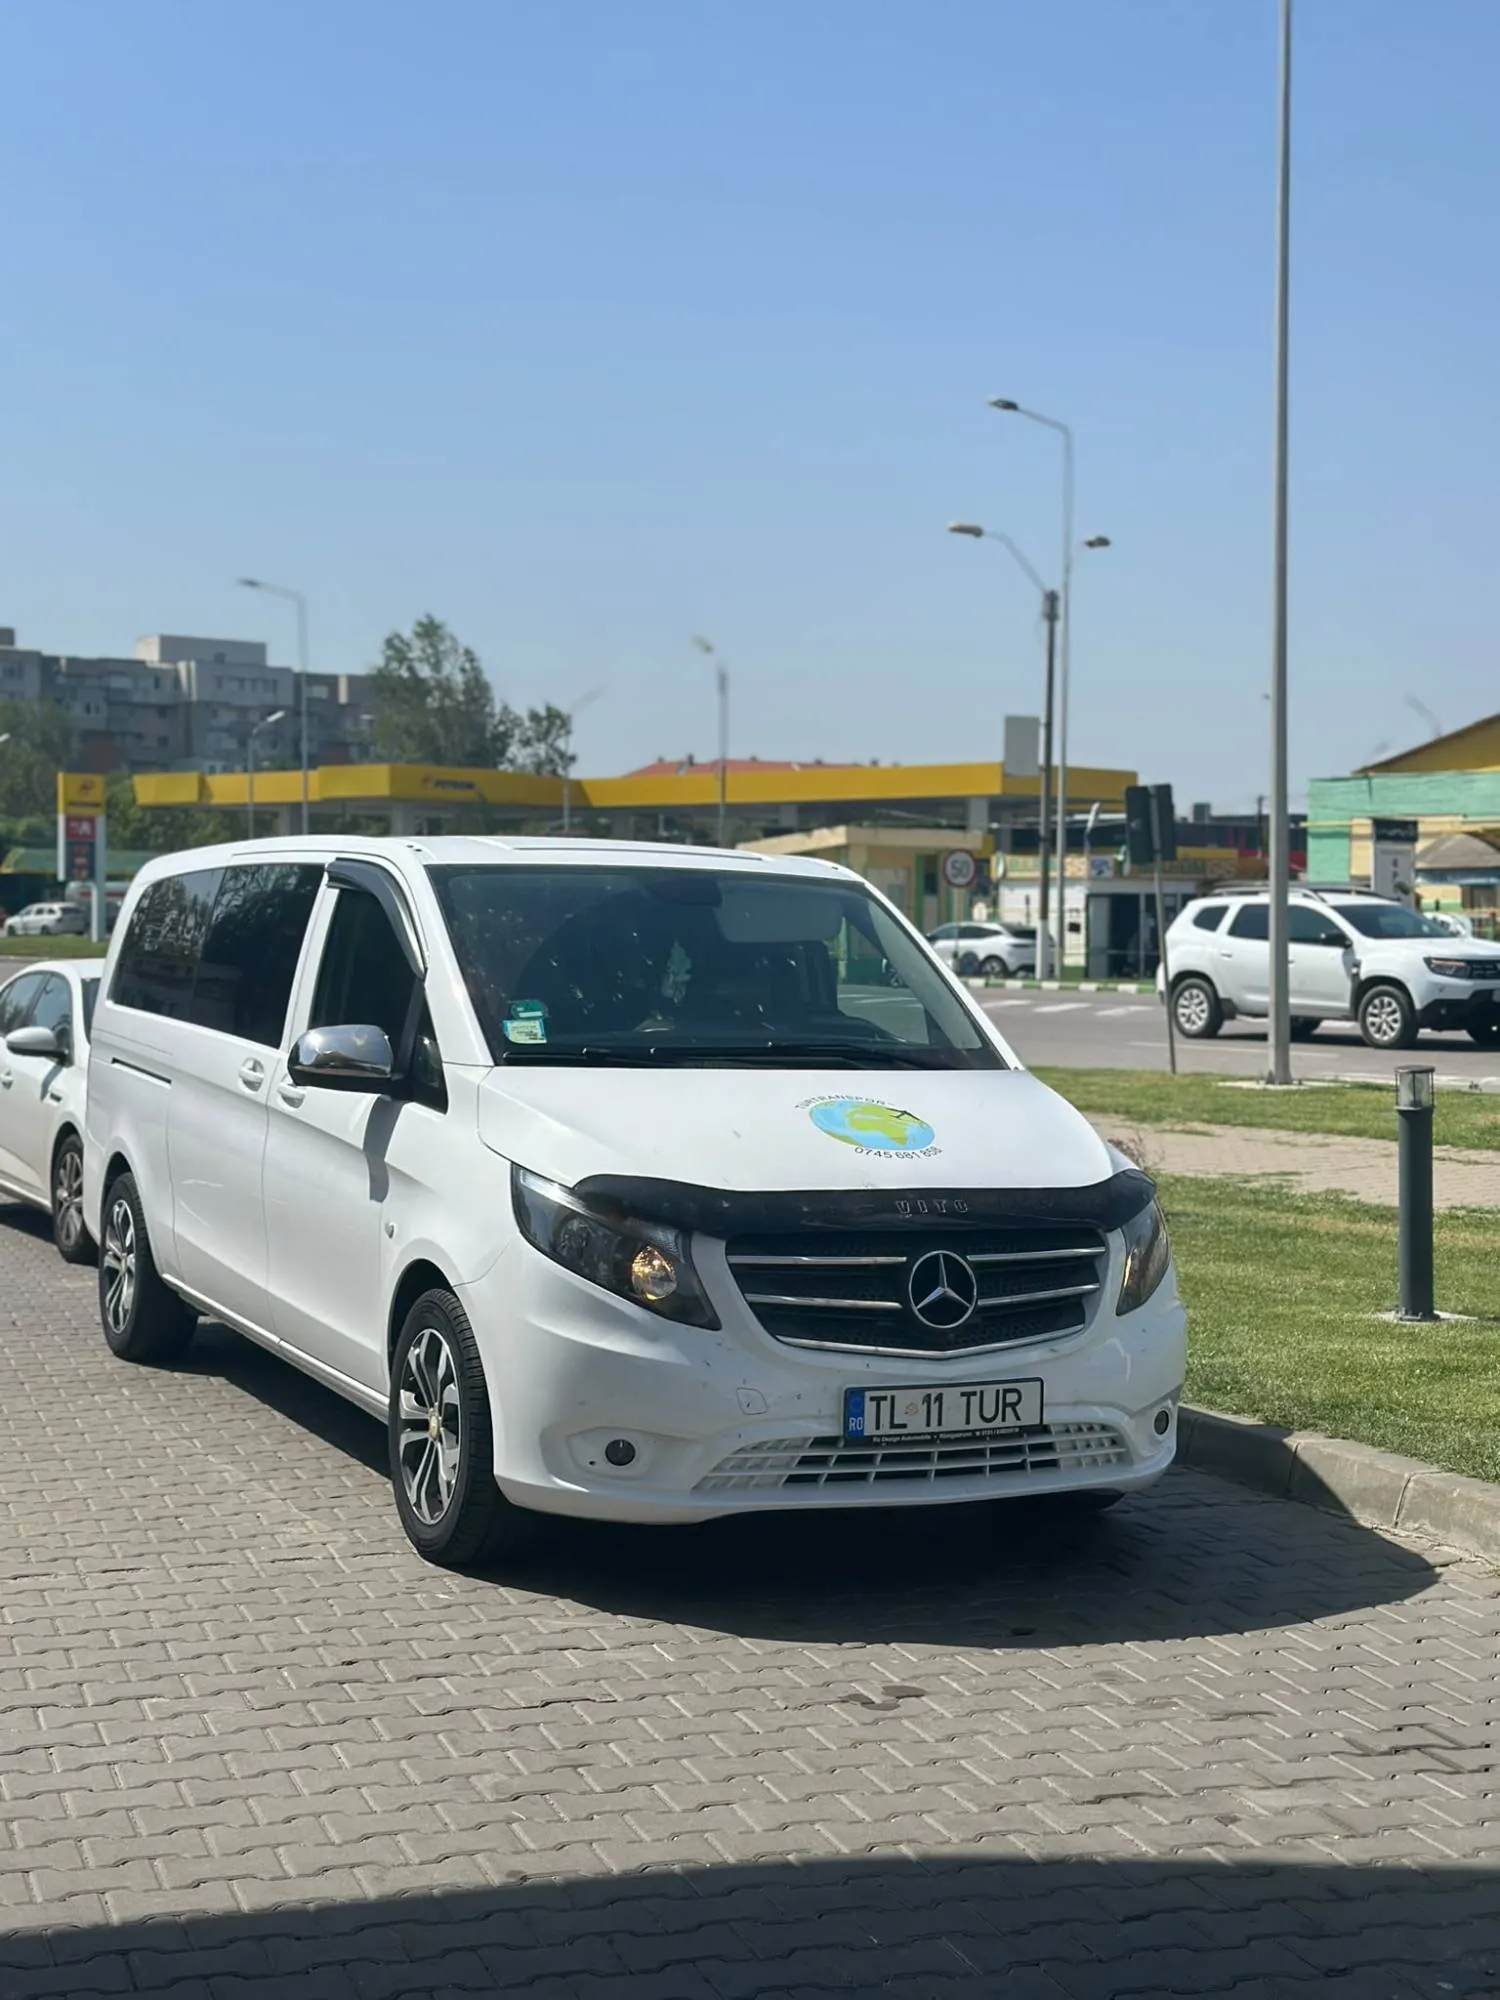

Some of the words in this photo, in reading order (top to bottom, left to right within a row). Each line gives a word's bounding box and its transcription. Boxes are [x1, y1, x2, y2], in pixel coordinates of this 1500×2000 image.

[950, 859, 971, 879] 50
[854, 1146, 893, 1159] 0745
[895, 1151, 921, 1160] 681
[895, 1199, 968, 1215] VITO
[869, 1395, 907, 1431] TL
[921, 1392, 944, 1428] 11
[960, 1388, 1022, 1425] TUR
[848, 1416, 864, 1431] RO
